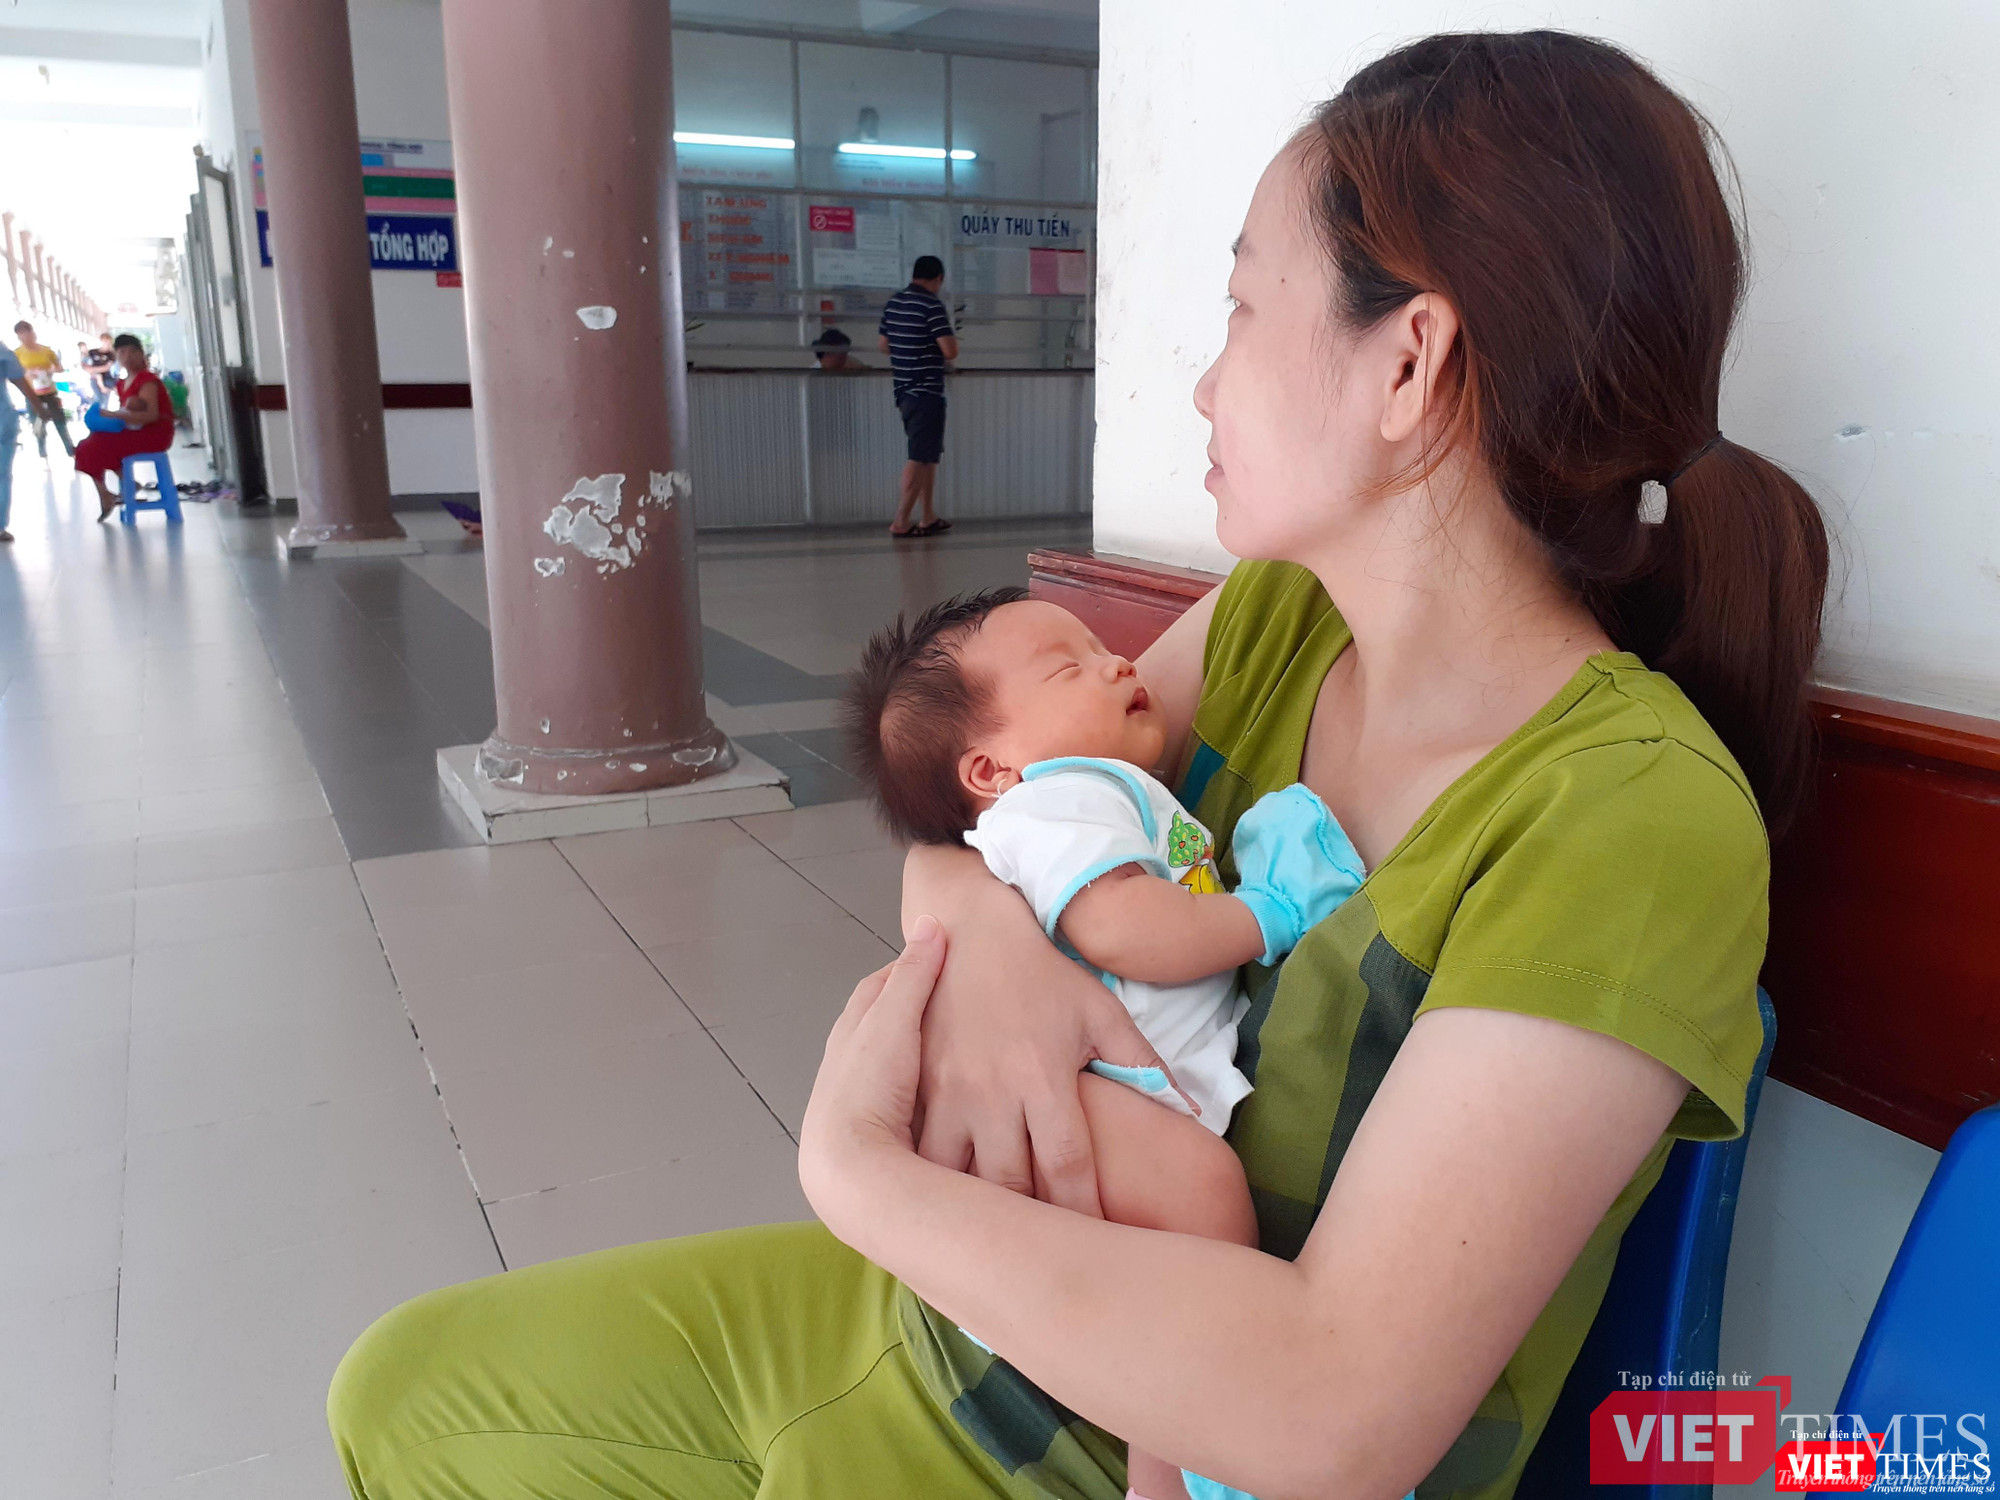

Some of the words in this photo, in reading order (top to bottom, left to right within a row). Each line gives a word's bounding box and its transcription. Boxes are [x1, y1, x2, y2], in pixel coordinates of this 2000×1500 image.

[1005, 217, 1033, 236] THU
[370, 220, 414, 262] TỔNG
[416, 228, 449, 267] HỢP
